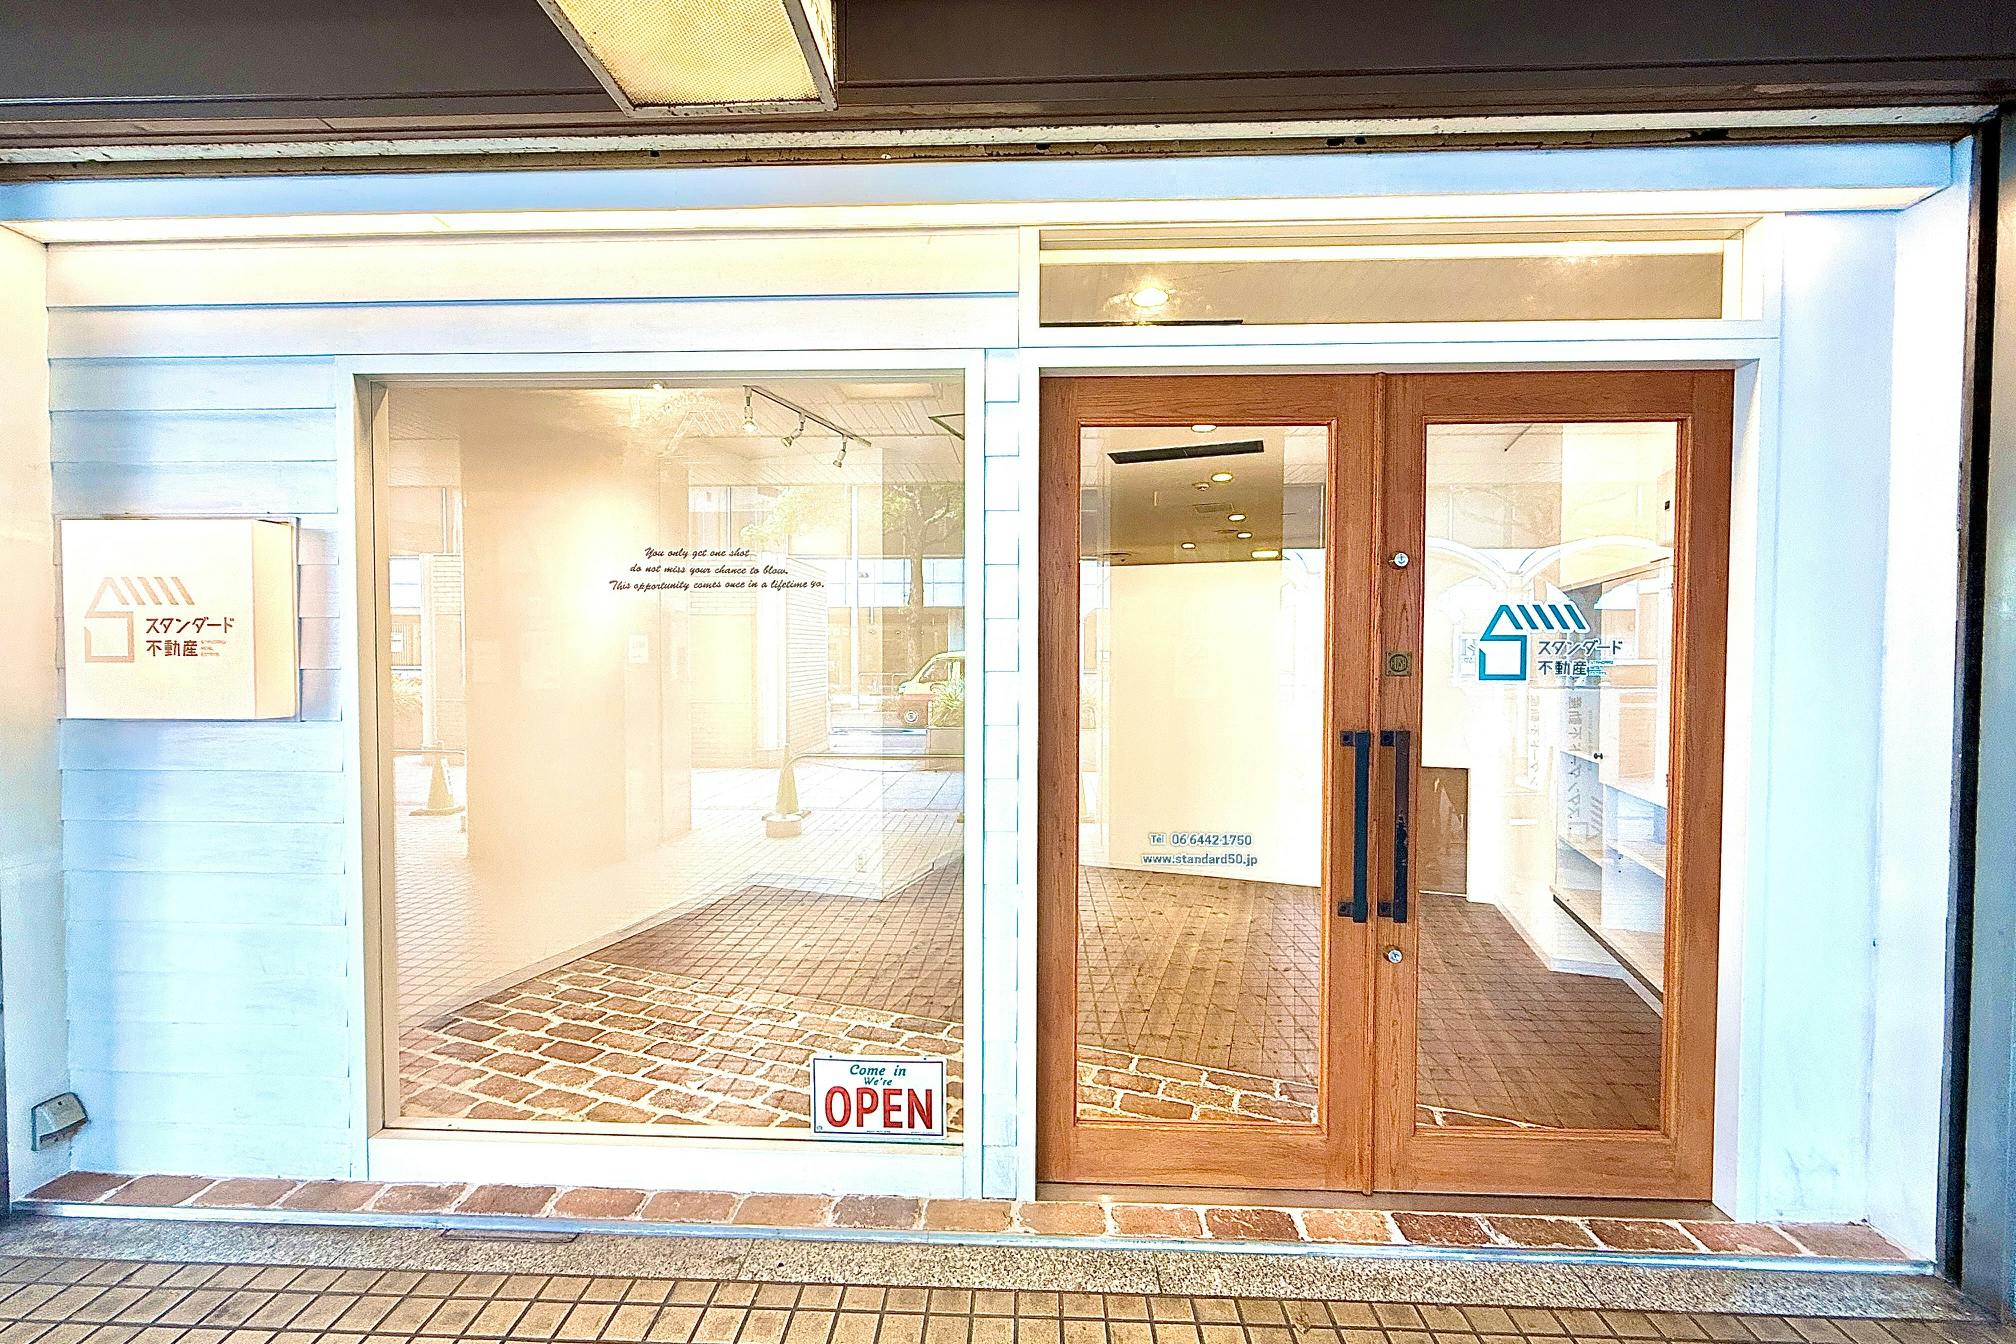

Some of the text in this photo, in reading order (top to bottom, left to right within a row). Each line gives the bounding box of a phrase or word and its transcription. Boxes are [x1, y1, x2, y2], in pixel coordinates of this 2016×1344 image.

[644, 547, 664, 557] You
[667, 547, 689, 559] only
[692, 548, 707, 560] get
[729, 548, 750, 557] shot
[630, 563, 642, 572] do
[645, 564, 661, 572] not
[664, 565, 686, 573] miss
[689, 567, 712, 576] your
[714, 565, 747, 574] chance
[749, 565, 760, 574] to
[609, 580, 631, 590] This
[633, 581, 690, 591] opportunity
[693, 581, 721, 589] comes
[747, 580, 758, 588] in
[770, 579, 808, 591] lifetime
[145, 616, 235, 634] スタンダード
[145, 639, 199, 657] 不動産
[1538, 640, 1623, 655] スタンダード
[1538, 660, 1587, 676] 不動産
[1150, 834, 1164, 844] Tel
[1143, 853, 1258, 867] www.standard50.jp
[849, 1064, 907, 1076] Come in
[863, 1077, 893, 1086] We're
[824, 1085, 933, 1130] OPEN
